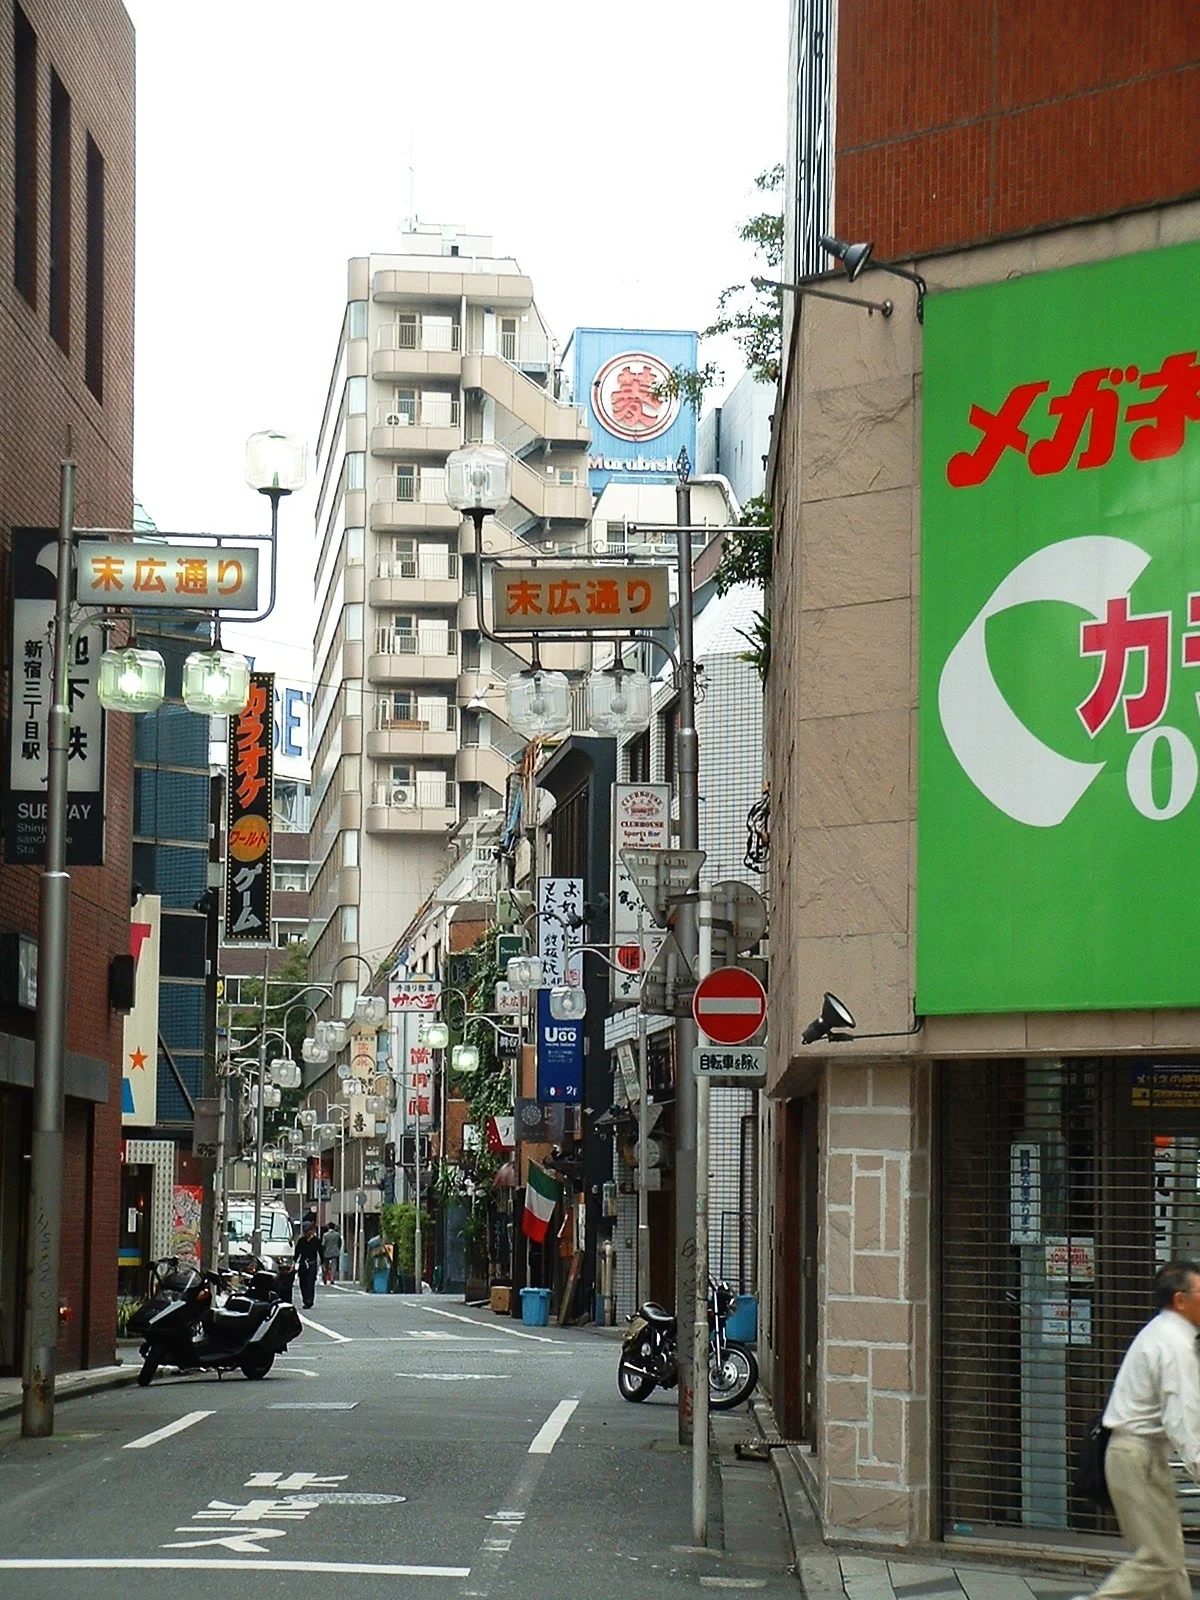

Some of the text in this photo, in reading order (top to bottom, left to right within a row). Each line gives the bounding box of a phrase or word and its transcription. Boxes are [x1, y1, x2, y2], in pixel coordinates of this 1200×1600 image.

[588, 453, 686, 472] Marubish
[90, 556, 244, 595] 末広通り
[506, 579, 653, 616] 末広通り
[22, 640, 43, 760] 新宿三丁目駅
[235, 682, 267, 810] カラオケ
[18, 803, 91, 820] SUBAY
[229, 830, 269, 848] ワールド
[232, 862, 263, 933] ゲーム
[545, 1027, 577, 1042] UGO
[700, 1054, 759, 1070] 自転車を除く
